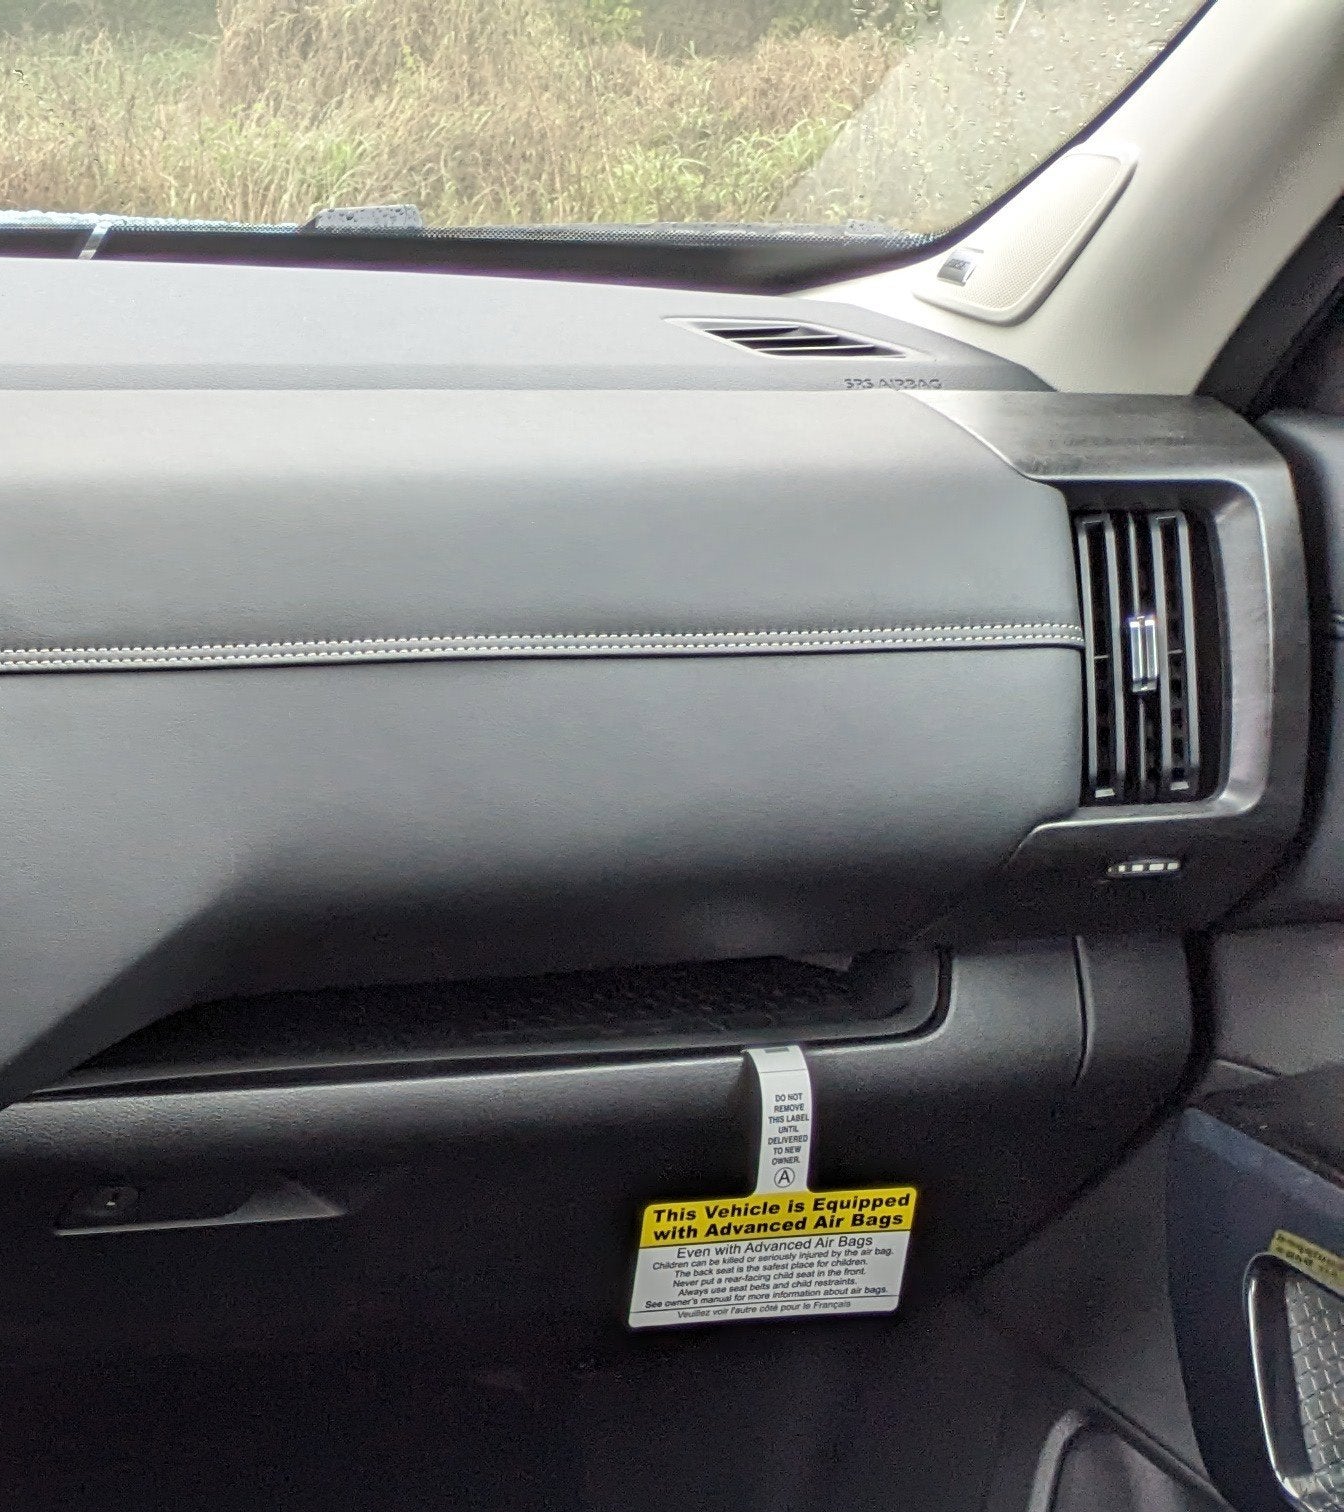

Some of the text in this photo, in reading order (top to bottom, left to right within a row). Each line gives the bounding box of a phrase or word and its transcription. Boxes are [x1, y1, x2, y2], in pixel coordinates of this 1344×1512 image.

[775, 1092, 803, 1103] DO NOT
[773, 1103, 805, 1113] REMOVE
[768, 1113, 810, 1124] THIS LABEL
[778, 1125, 799, 1134] UNTIL
[767, 1134, 809, 1145] DELIVERED
[773, 1145, 802, 1155] TO NEW
[653, 1193, 911, 1223] This Vehicle is Equipped
[653, 1213, 904, 1241] with Advanced Air Bags
[677, 1236, 873, 1259] Even with Advanced Air Bags
[652, 1260, 689, 1271] Children
[690, 1260, 707, 1268] can
[708, 1258, 720, 1266] be
[722, 1256, 744, 1264] killed
[758, 1252, 797, 1262] seriously
[799, 1250, 829, 1260] injured
[831, 1249, 842, 1258] by
[844, 1248, 858, 1256] the
[860, 1248, 873, 1256] air
[674, 1270, 692, 1278] The
[693, 1268, 713, 1277] back
[716, 1266, 735, 1275] seat
[746, 1264, 760, 1273] the
[762, 1262, 789, 1271] safest
[790, 1260, 815, 1270] place
[816, 1259, 829, 1268] for
[672, 1279, 699, 1288] Never
[700, 1277, 715, 1286] put
[724, 1273, 771, 1284] rear-facing
[773, 1271, 794, 1280] child
[795, 1270, 816, 1278] seat
[827, 1268, 842, 1277] the
[677, 1288, 708, 1297] Always
[729, 1284, 748, 1293] seat
[749, 1283, 771, 1291] belts
[772, 1281, 790, 1290] and
[791, 1279, 813, 1289] child
[645, 1300, 663, 1309] See
[700, 1295, 732, 1304] manual
[734, 1293, 745, 1301] for
[747, 1292, 770, 1300] more
[772, 1289, 821, 1299] information
[823, 1287, 848, 1296] about
[850, 1286, 862, 1295] air
